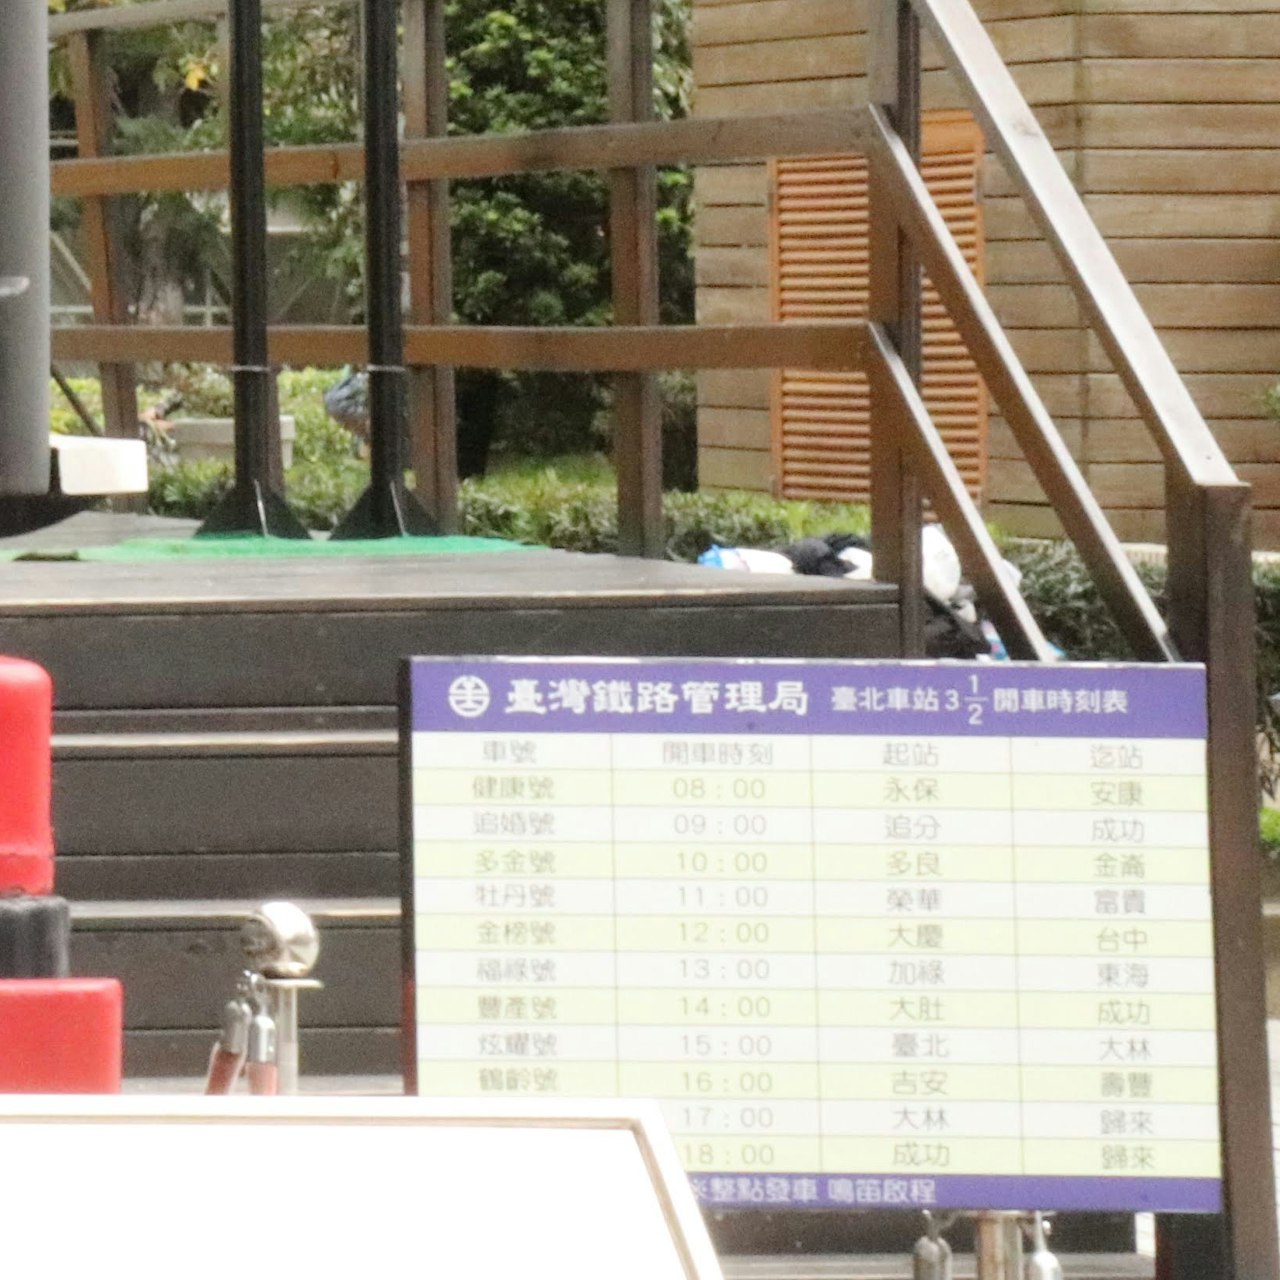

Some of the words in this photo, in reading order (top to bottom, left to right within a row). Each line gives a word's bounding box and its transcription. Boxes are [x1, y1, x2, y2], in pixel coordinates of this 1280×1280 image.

[504, 678, 809, 718] 臺灣鐵路管理局
[483, 740, 536, 764] 車號
[662, 740, 773, 766] 開車時刻
[882, 742, 939, 767] 起站
[1090, 744, 1144, 770] 迄站
[472, 775, 554, 800] 健康號
[885, 777, 938, 803] 永保
[1091, 780, 1143, 807] 安康
[885, 814, 944, 842] 追分
[1090, 817, 1147, 845] 成功
[476, 849, 556, 874] 多金號
[887, 850, 941, 878] 多良
[475, 883, 555, 908] 牡丹號
[887, 888, 940, 912] 榮華
[1094, 889, 1145, 915] 富貴
[891, 923, 943, 949] 大慶
[1096, 927, 1148, 952] 台中
[1097, 962, 1149, 989] 東海
[890, 995, 944, 1023] 大肚
[1097, 999, 1153, 1028] 成功
[892, 1032, 949, 1060] 臺北
[1100, 1038, 1151, 1063] 大林
[892, 1069, 948, 1097] 吉安
[896, 1107, 948, 1130] 大林
[1100, 1109, 1153, 1135] 歸來
[892, 1141, 950, 1168] 成功
[1101, 1144, 1153, 1172] 歸來
